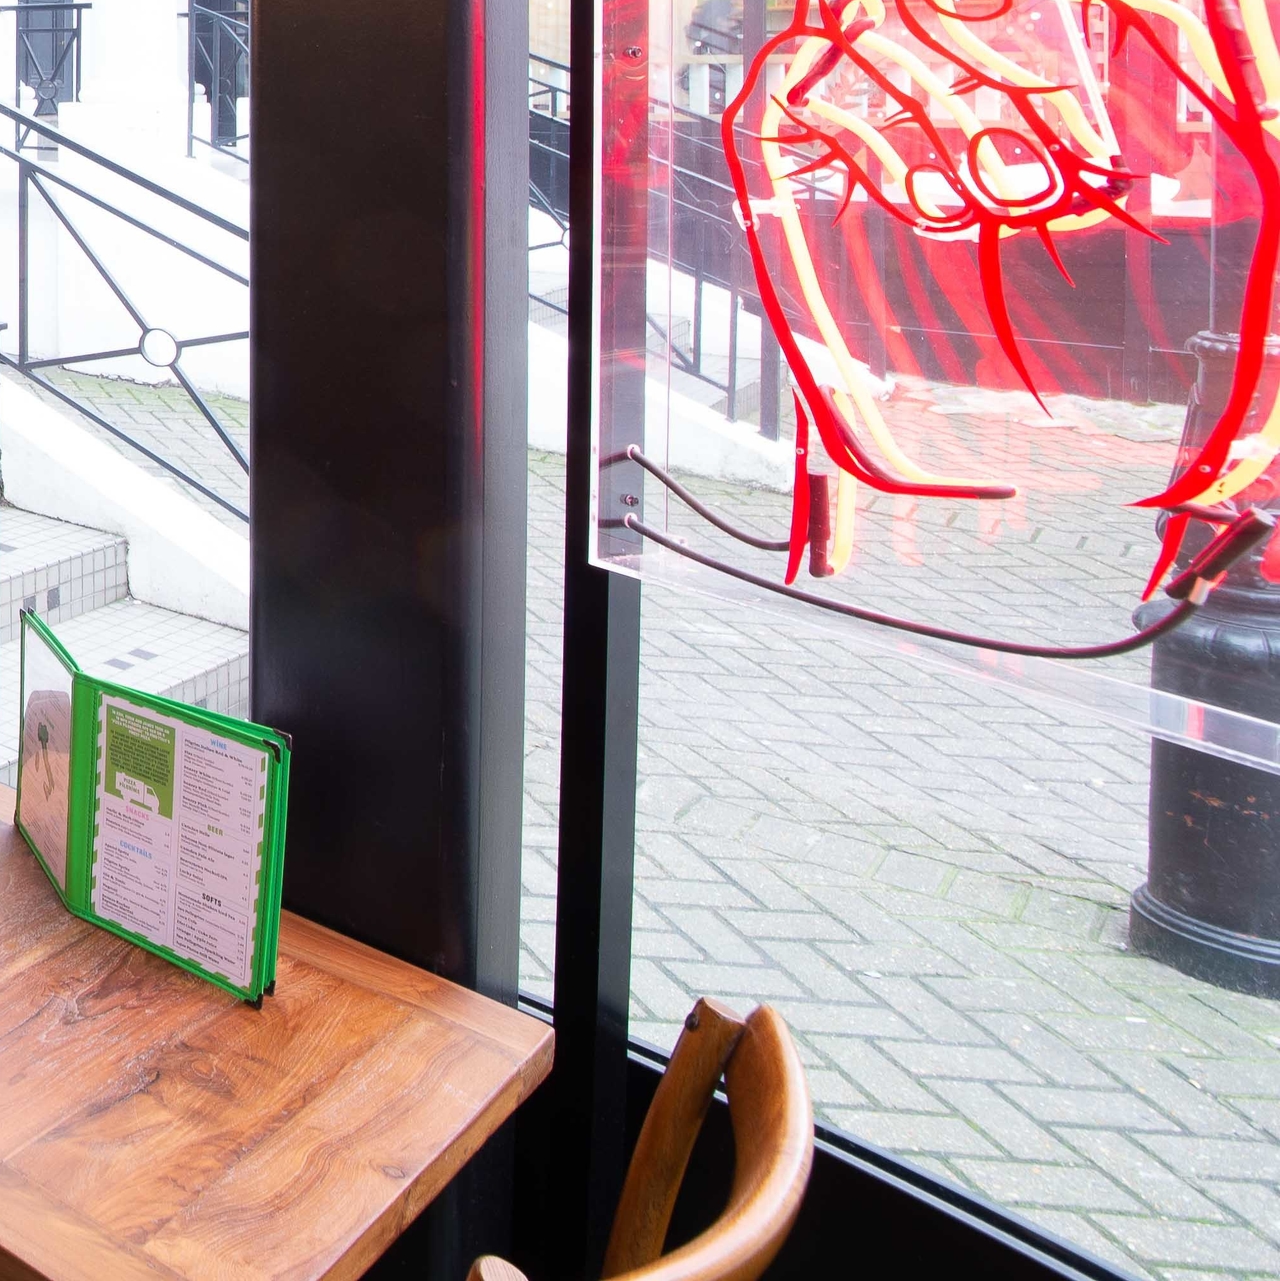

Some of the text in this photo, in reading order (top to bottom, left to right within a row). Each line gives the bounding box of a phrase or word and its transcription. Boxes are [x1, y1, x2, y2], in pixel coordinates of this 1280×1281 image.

[210, 738, 227, 750] WiNE
[125, 806, 149, 821] SNACKS
[207, 824, 223, 836] BEER
[119, 838, 151, 859] COCKTAiLS
[202, 893, 221, 906] SOFTS
